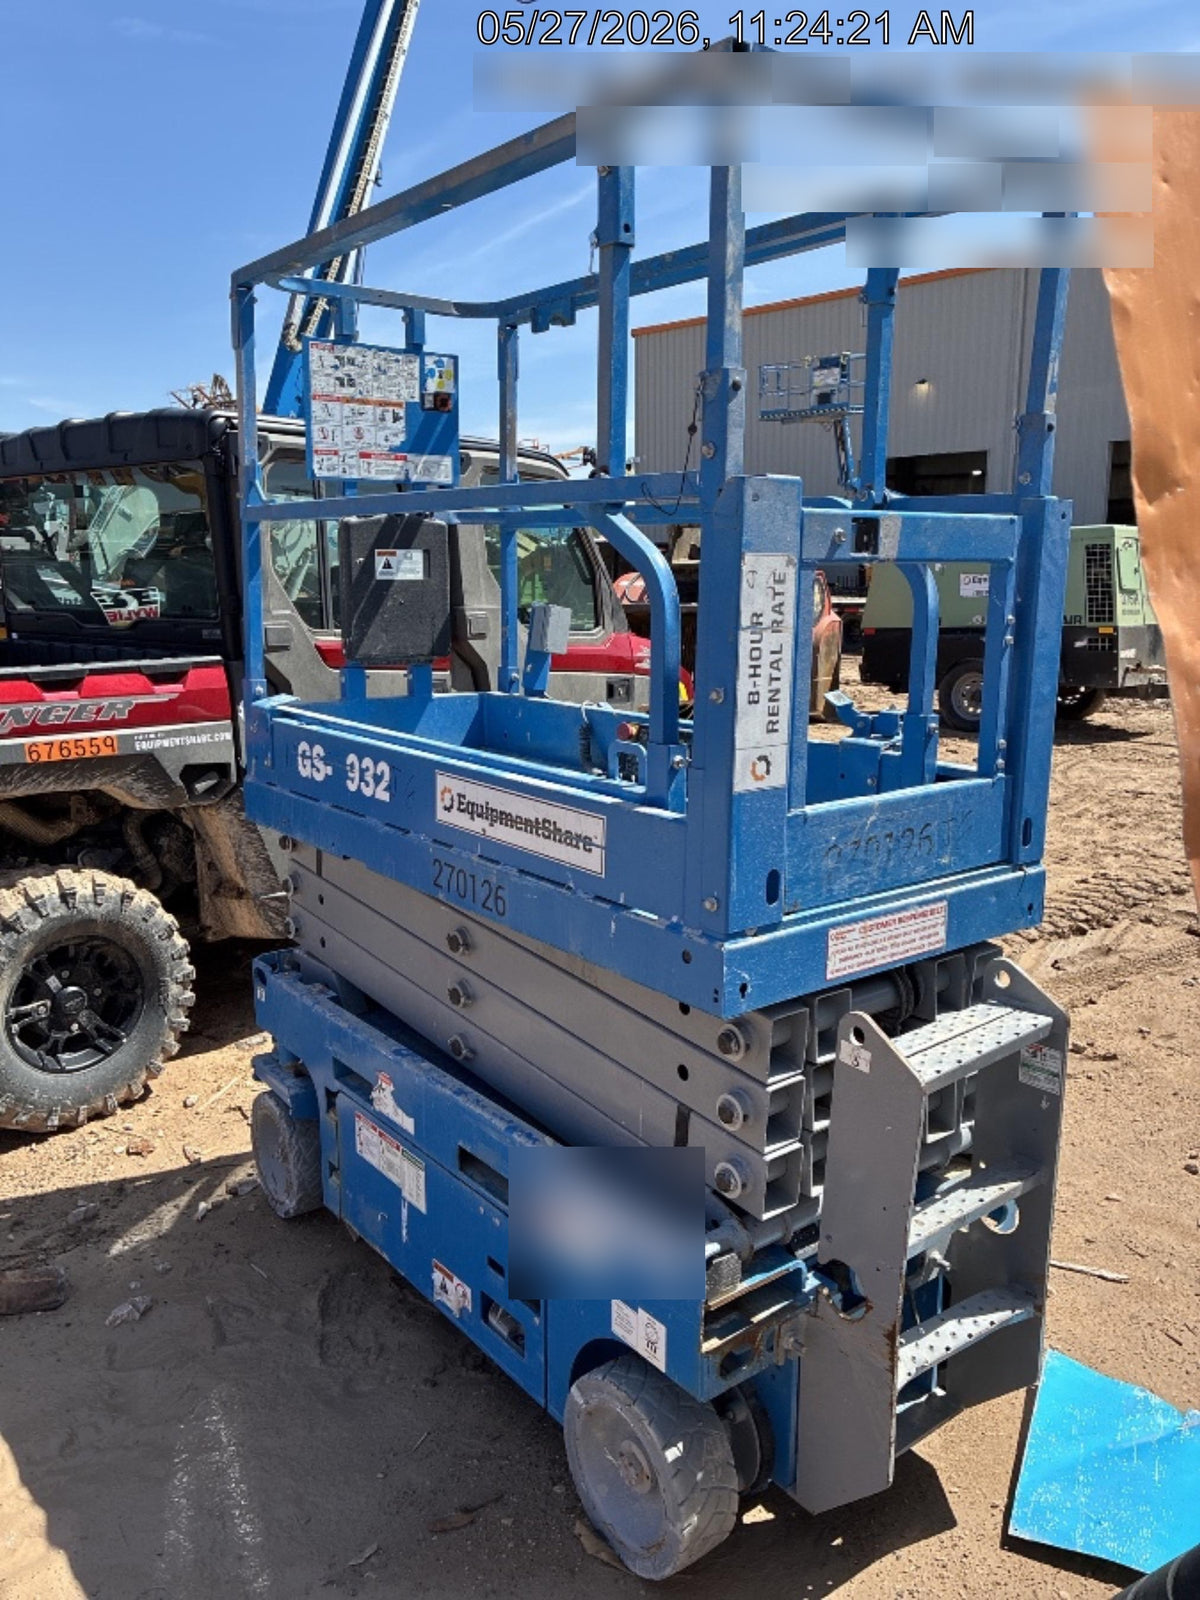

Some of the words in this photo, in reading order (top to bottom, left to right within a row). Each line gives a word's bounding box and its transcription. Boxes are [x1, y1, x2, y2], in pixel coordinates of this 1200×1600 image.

[771, 572, 786, 634] RATE
[748, 612, 763, 705] 8-HOUR
[766, 643, 783, 735] RENTAL
[0, 699, 136, 729] NGER
[27, 735, 116, 762] 676559
[457, 792, 594, 853] EquipmentShare
[433, 858, 506, 917] 270126
